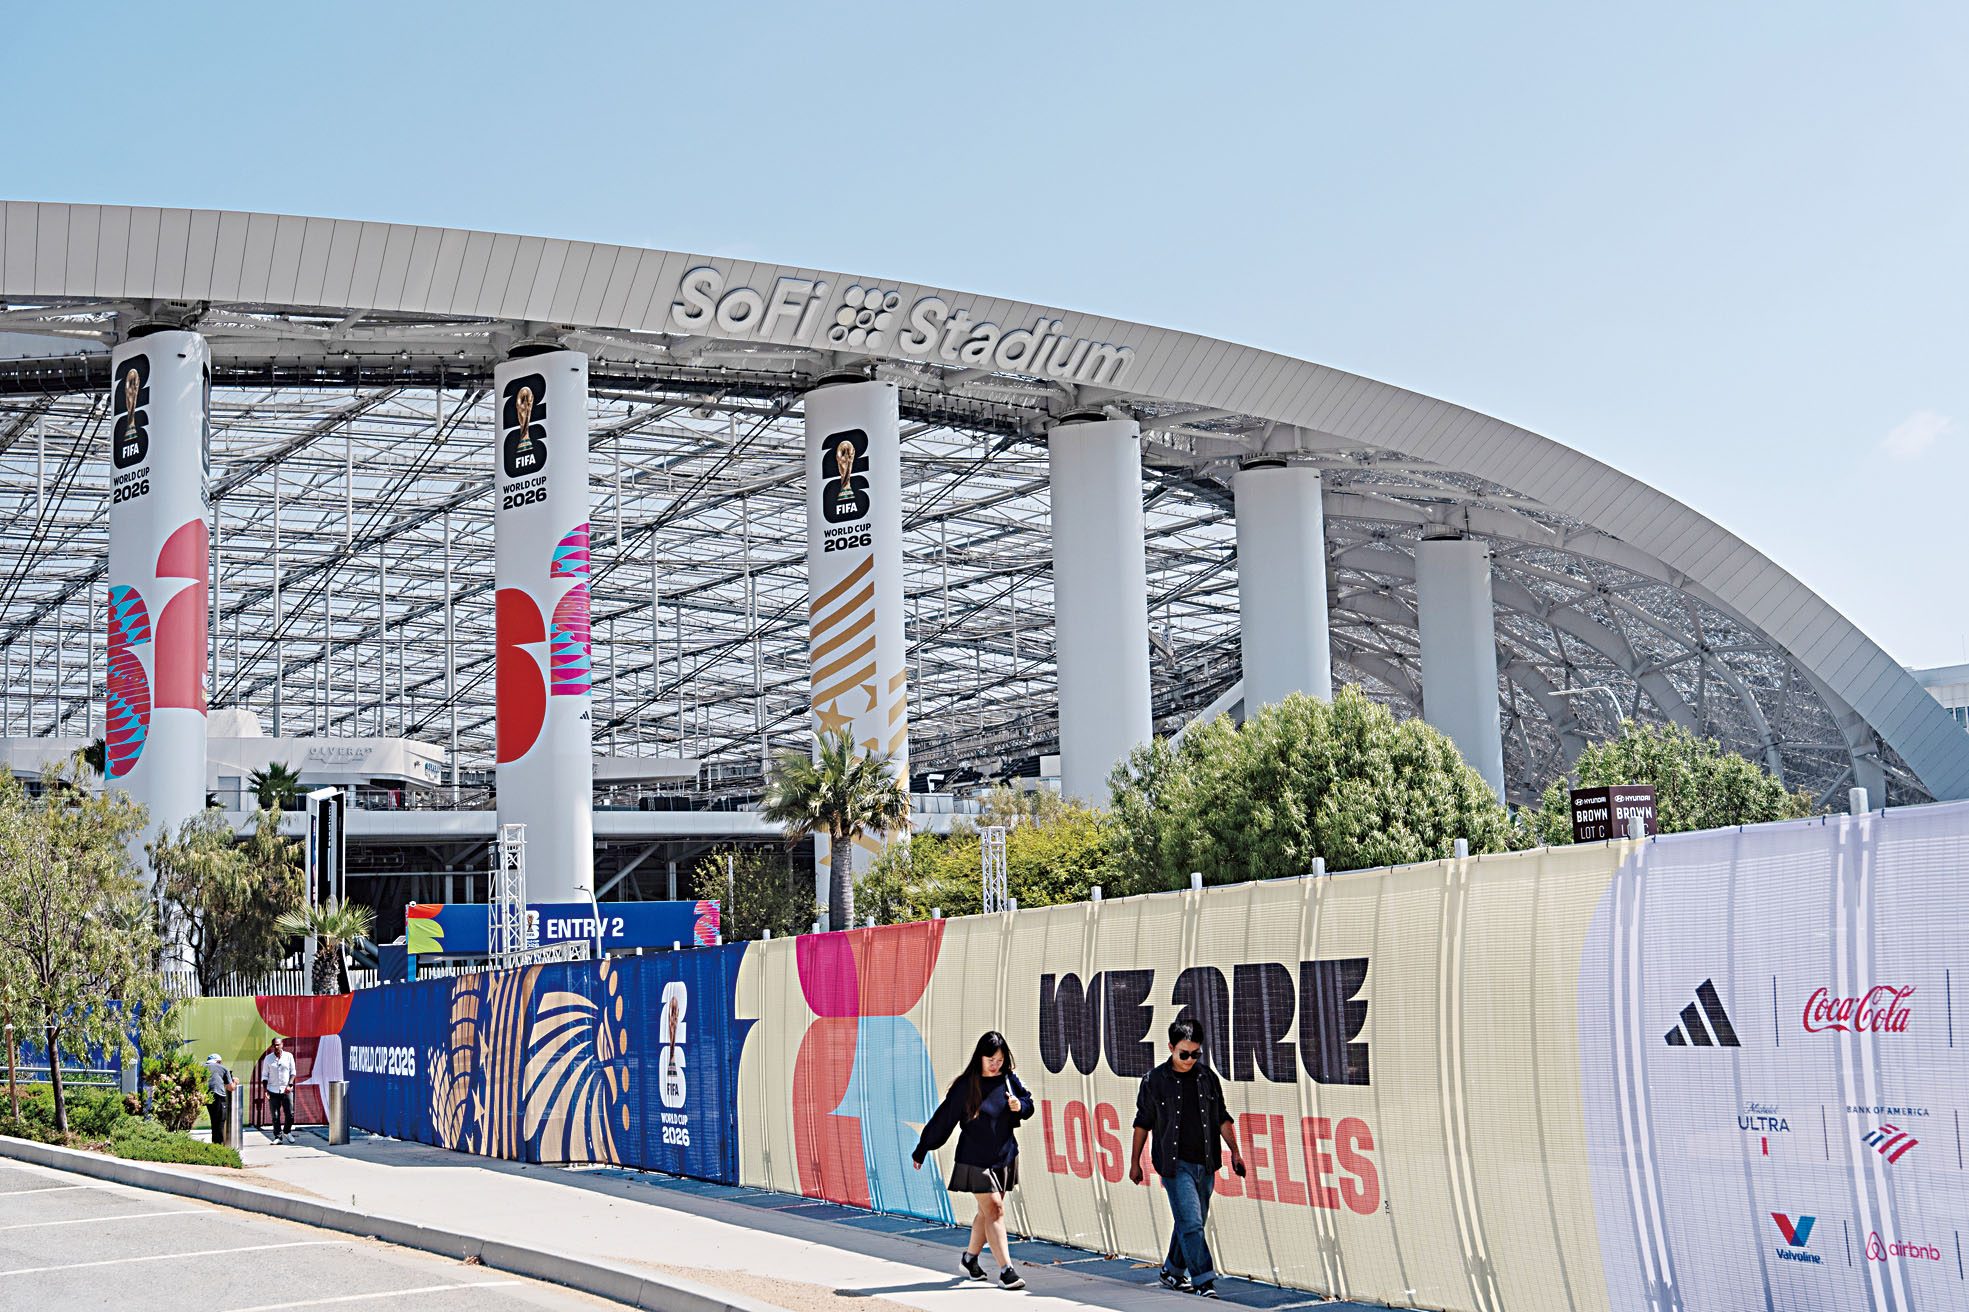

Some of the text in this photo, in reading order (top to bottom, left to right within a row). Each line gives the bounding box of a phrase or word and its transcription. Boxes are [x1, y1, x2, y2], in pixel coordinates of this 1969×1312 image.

[671, 266, 1136, 386] SoFi Stadium
[122, 442, 140, 459] FIFA
[515, 454, 536, 469] FIFA
[113, 466, 150, 486] WORLD CUP
[503, 476, 547, 494] WORLD CUP
[113, 479, 150, 504] 2026
[503, 487, 547, 510] 2026
[836, 502, 858, 515] FIFA
[824, 523, 872, 538] WORLD CUP
[824, 533, 872, 553] 2026
[1576, 808, 1608, 823] BROWN
[1616, 806, 1653, 819] BROWN
[1580, 826, 1595, 840] LOT
[1598, 825, 1605, 838] C
[547, 917, 624, 939] ENTRY 2
[1803, 985, 1917, 1033] Coca-Cola
[1039, 957, 1371, 1086] WE ARE
[358, 1045, 374, 1073] WORLD
[374, 1045, 388, 1074] CUP
[388, 1046, 416, 1077] 2026
[666, 1082, 680, 1097] FIFA
[661, 1112, 689, 1126] WORLD CUP
[1846, 1106, 1930, 1117] BANK OF AMERICA
[1738, 1115, 1790, 1132] ULTRA
[662, 1126, 690, 1147] 2026
[1041, 1099, 1125, 1184] LOS
[1776, 1248, 1821, 1264] Valvoline
[1889, 1240, 1941, 1261] airbnb
